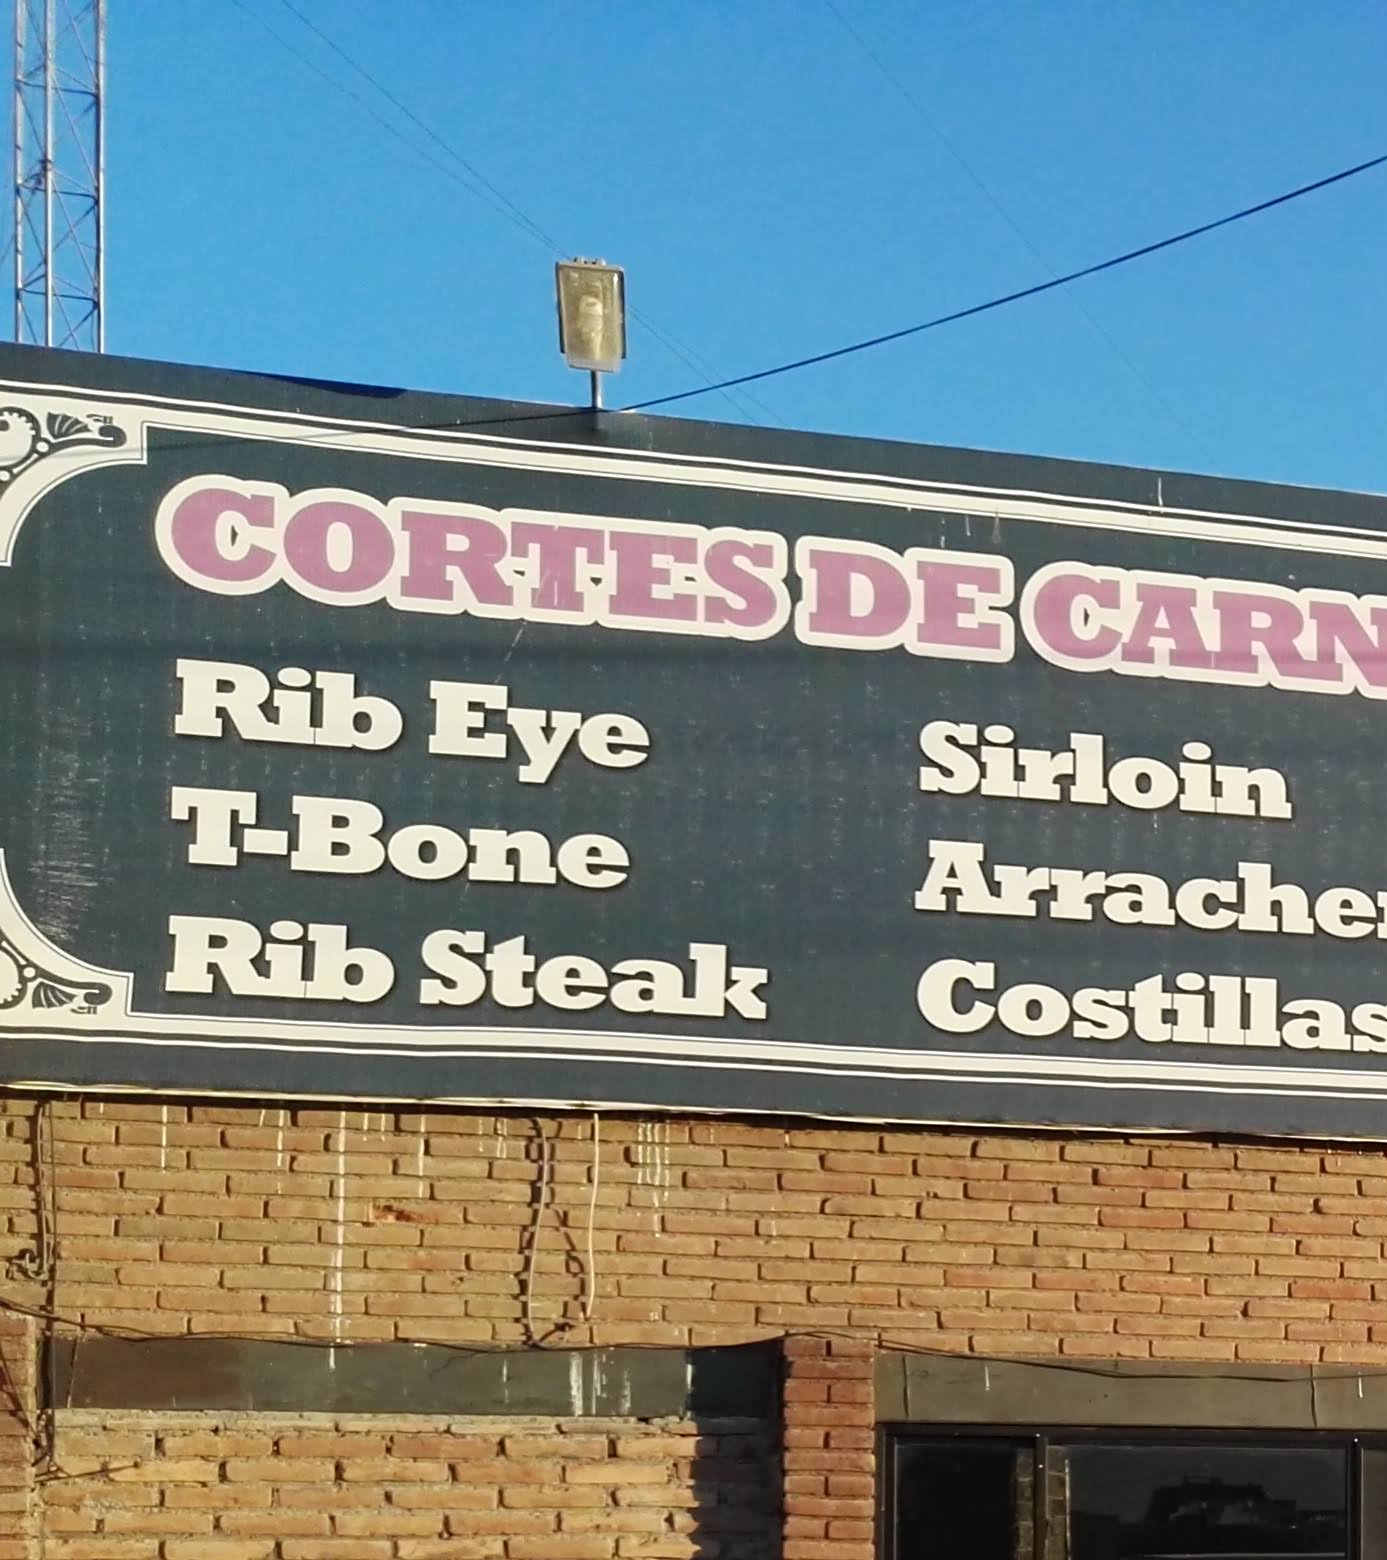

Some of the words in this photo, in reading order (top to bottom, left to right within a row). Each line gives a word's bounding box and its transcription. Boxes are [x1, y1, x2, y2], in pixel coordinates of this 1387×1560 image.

[157, 476, 786, 640] CORTES
[797, 538, 1013, 661] DE
[174, 658, 402, 752] Rib
[428, 680, 651, 784] Eye
[919, 720, 1292, 819] Sirloin
[171, 786, 631, 889] T-Bone
[164, 914, 396, 1004] Rib
[420, 929, 769, 1021] Steak
